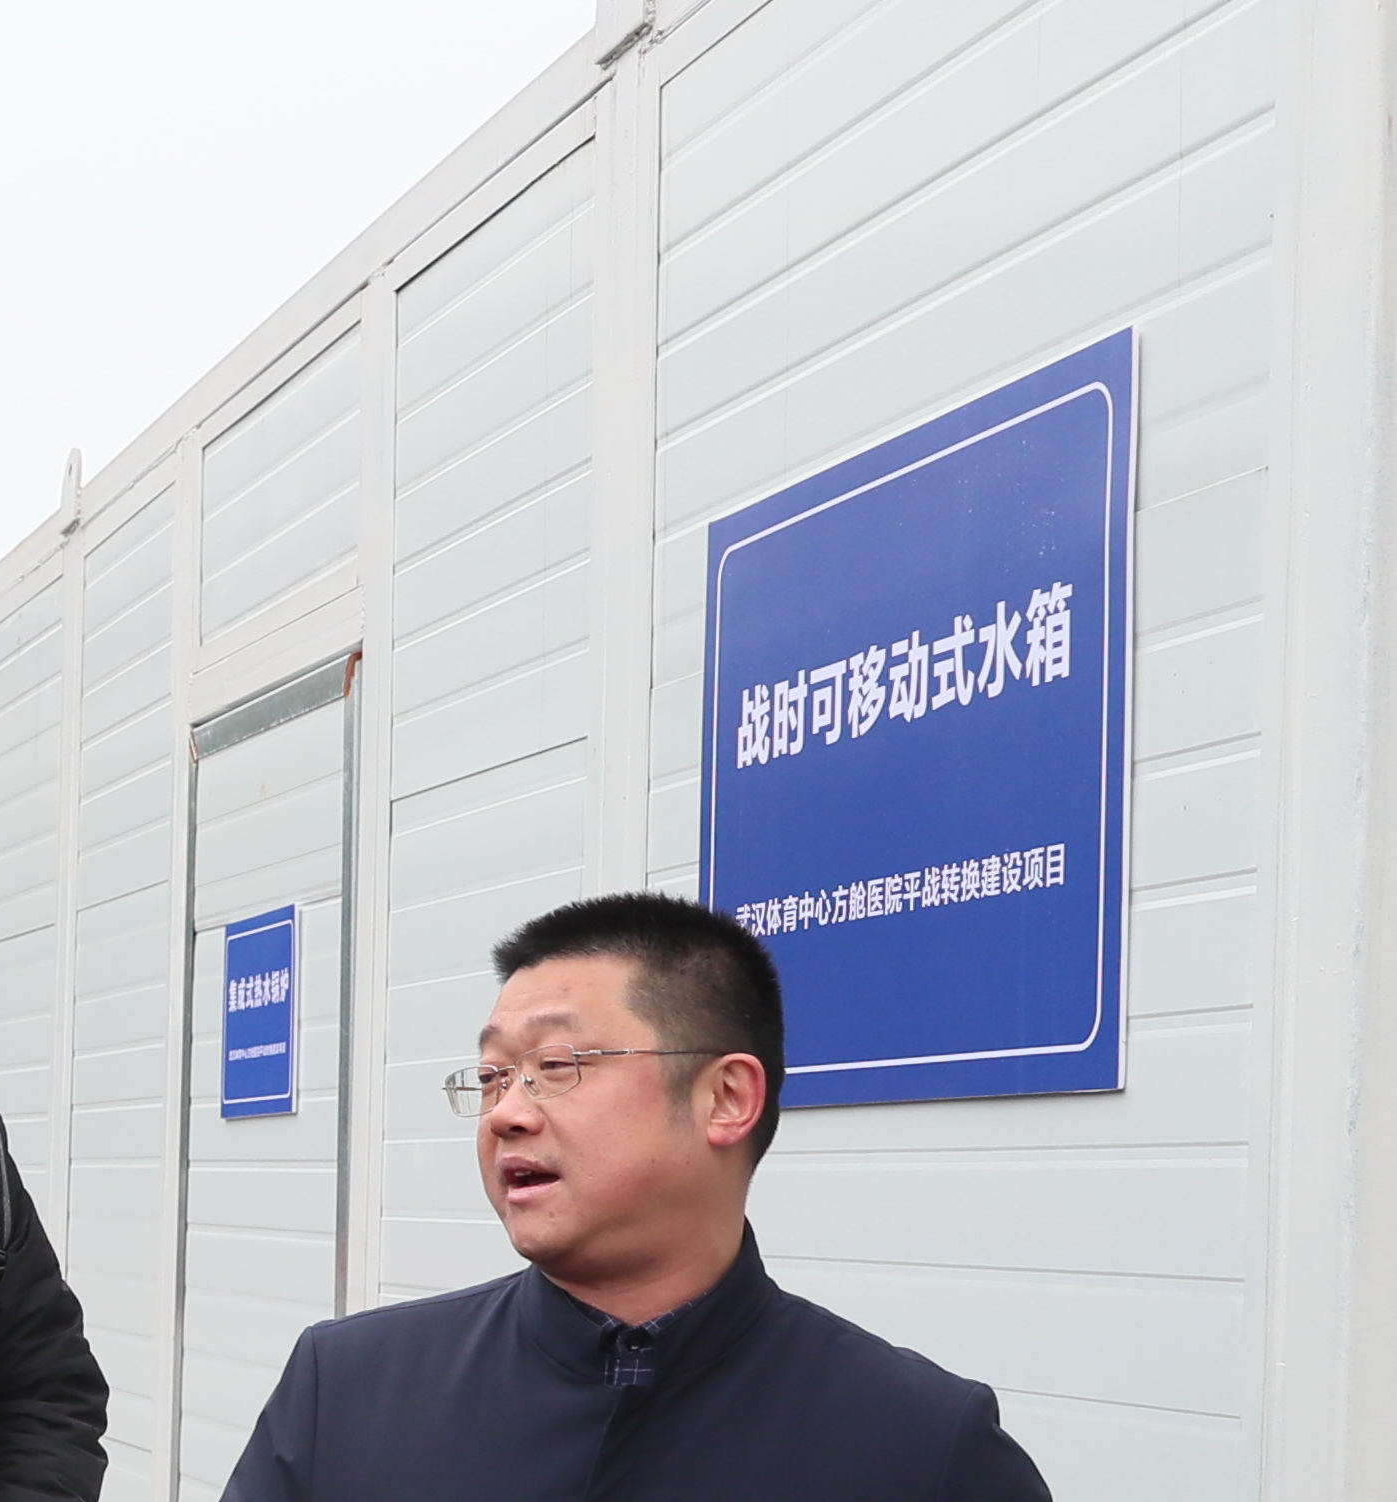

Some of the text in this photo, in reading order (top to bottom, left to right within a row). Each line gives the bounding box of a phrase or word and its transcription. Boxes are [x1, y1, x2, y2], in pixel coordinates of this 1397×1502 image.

[736, 581, 1073, 769] 战时可移动式水箱
